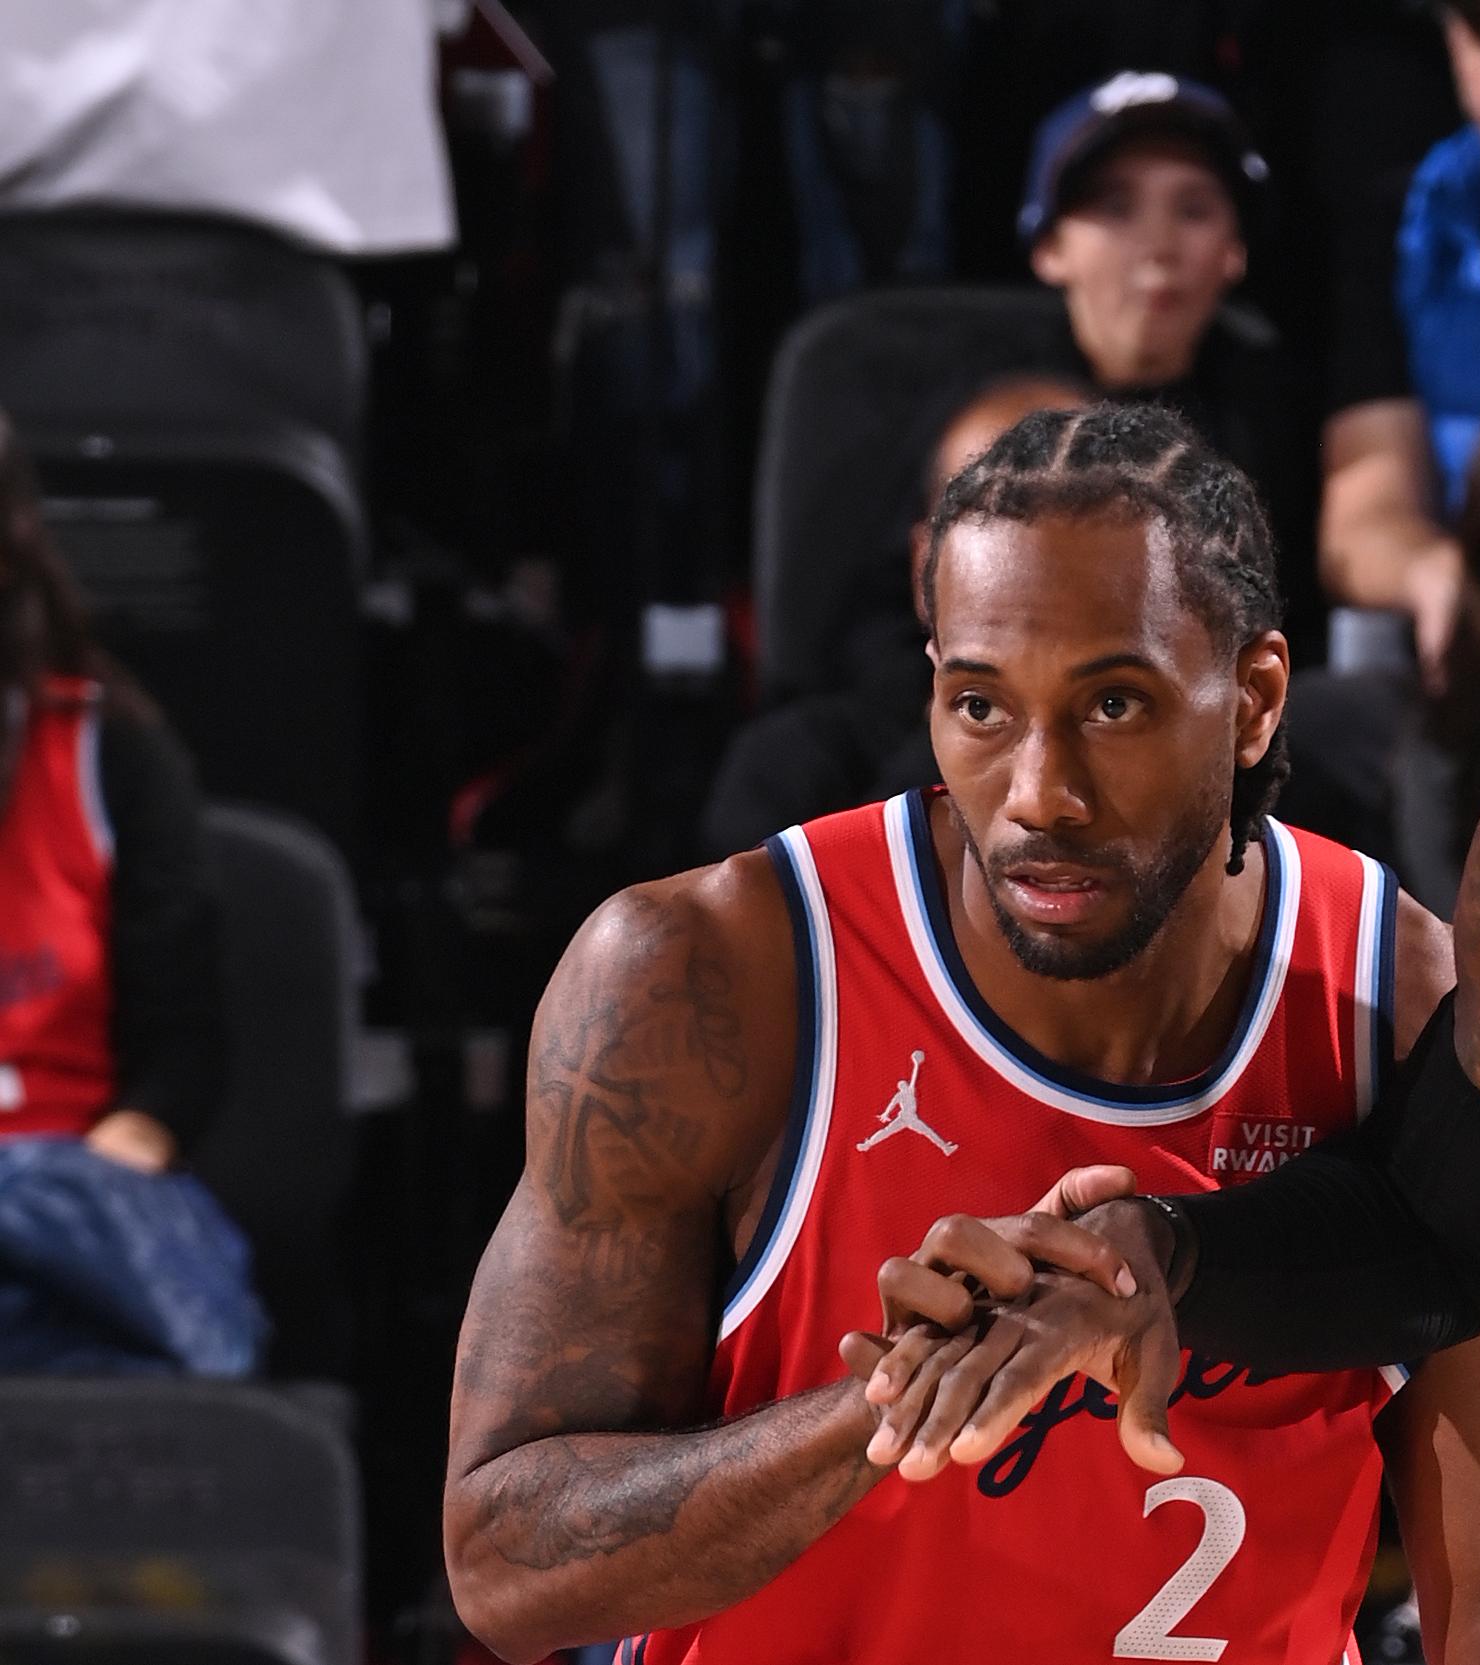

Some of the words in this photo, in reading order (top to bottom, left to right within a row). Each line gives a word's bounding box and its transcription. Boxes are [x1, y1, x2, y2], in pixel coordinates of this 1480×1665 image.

[1242, 1122, 1316, 1149] VISIT
[1212, 1147, 1301, 1173] RWA
[1113, 1476, 1247, 1663] 2
